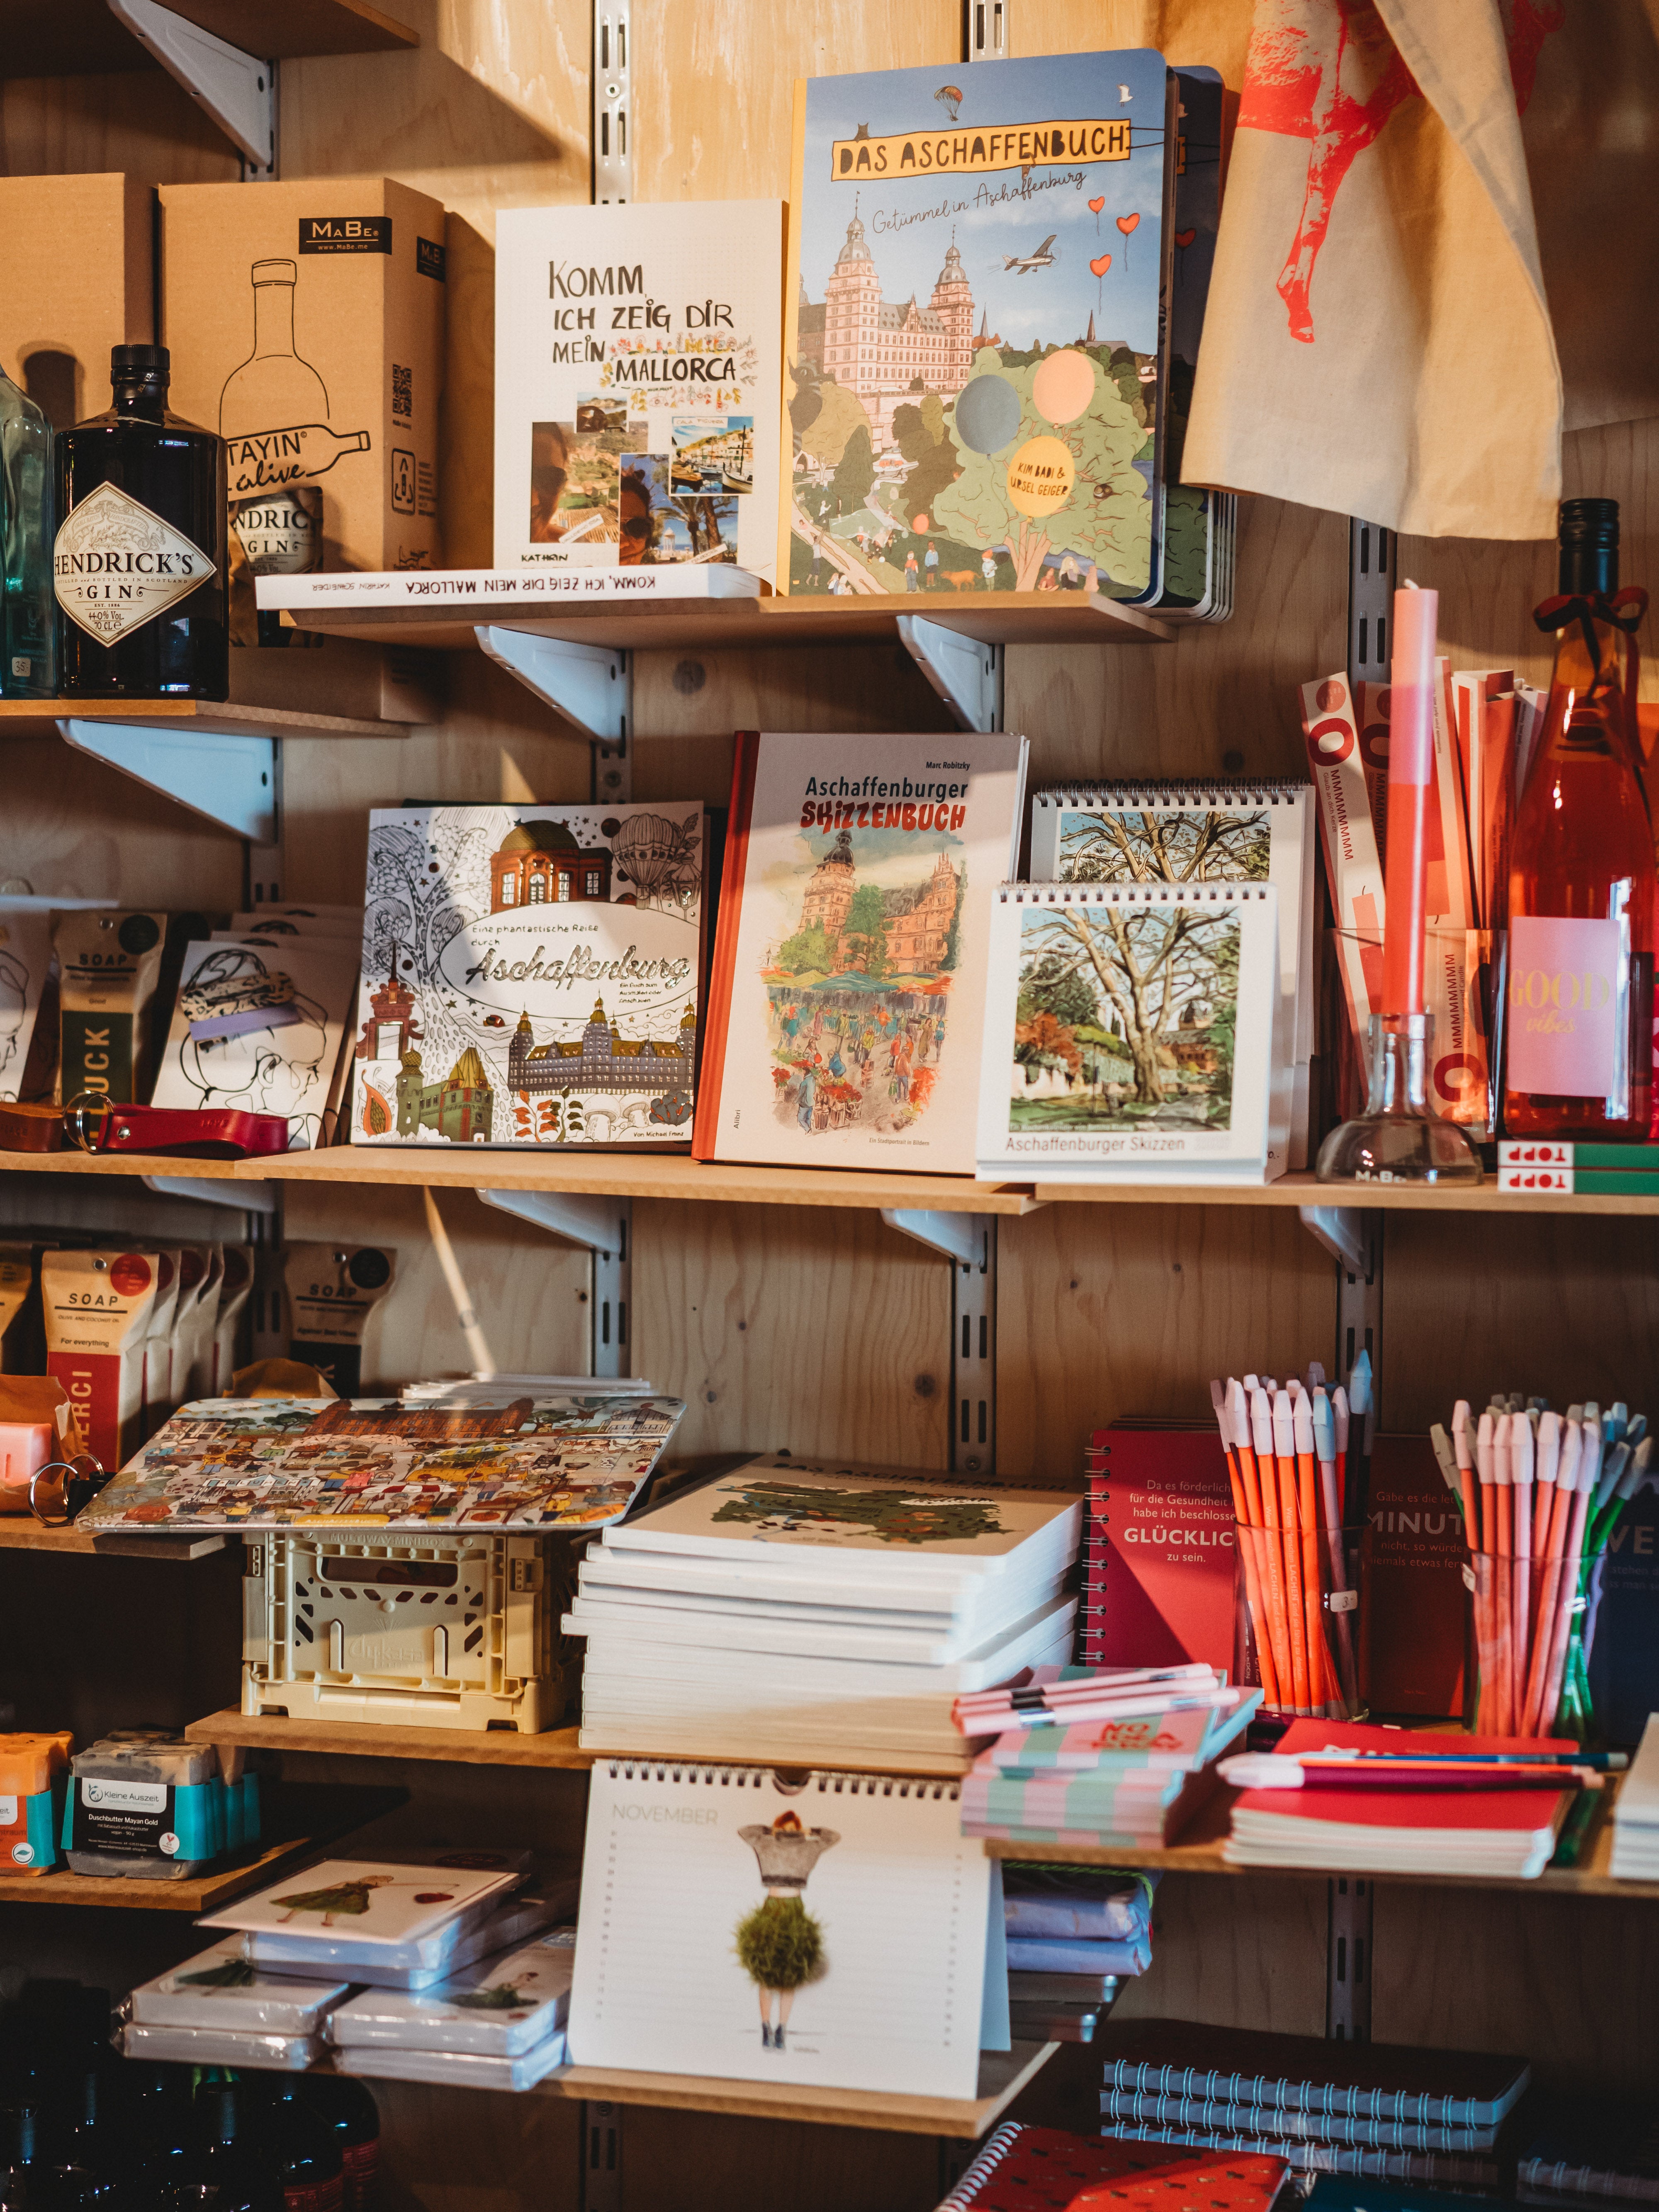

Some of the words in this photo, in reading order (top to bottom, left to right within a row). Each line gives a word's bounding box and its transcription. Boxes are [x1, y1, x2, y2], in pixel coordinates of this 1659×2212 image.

[841, 145, 888, 174] DAS
[901, 125, 1124, 169] ASCHAFFENBUCH
[873, 201, 951, 234] Getümmel
[953, 197, 969, 213] in
[973, 170, 1087, 209] Aschaffenburg
[554, 307, 595, 331] ICH
[612, 299, 671, 333] ZEIG
[686, 299, 734, 329] DIR
[553, 335, 605, 363] MEIN
[616, 357, 736, 382] MALLORCA
[236, 460, 305, 491] alive
[1018, 462, 1033, 476] KIM
[1035, 465, 1055, 478] BADI
[1057, 467, 1065, 479] &
[1011, 476, 1034, 494] URSEL
[1038, 484, 1068, 496] GEIGER
[109, 514, 146, 529] HANDCRAFTED
[248, 540, 288, 552] GIN
[55, 553, 193, 575] HENDRICK'S
[406, 581, 476, 594] MALLORCA
[484, 580, 516, 591] MEIN
[523, 579, 545, 590] DIR
[550, 577, 579, 590] ZEIG
[586, 579, 604, 590] ICH
[87, 585, 132, 599] GIN
[94, 621, 102, 630] 70
[943, 762, 970, 771] Robitzky
[805, 776, 968, 803] Aschaffenburger
[1330, 815, 1338, 832] Kerze
[496, 924, 569, 934] phantastische
[80, 954, 127, 966] SOAP
[465, 945, 690, 990] Aschaffenburg
[1510, 969, 1610, 1010] GOOD
[1527, 1010, 1576, 1033] vibes
[1006, 1137, 1125, 1154] Aschaffenburger
[1130, 1137, 1185, 1151] Skizzen
[1508, 1147, 1566, 1161] TOPP
[1508, 1174, 1566, 1188] TOPP
[310, 1284, 357, 1298] SOAP
[68, 1293, 118, 1306] SOAP
[74, 1339, 109, 1348] everything
[1147, 1480, 1161, 1490] Da
[1180, 1481, 1230, 1492] förderlich
[1130, 1493, 1144, 1503] für
[1148, 1494, 1163, 1504] die
[1167, 1494, 1227, 1506] Gesundheit
[1408, 1494, 1418, 1502] es
[1422, 1493, 1437, 1503] die
[1133, 1507, 1158, 1518] habe
[1162, 1509, 1176, 1518] ich
[1180, 1510, 1236, 1521] beschlosse
[1124, 1525, 1233, 1546] GLÜCKLIC
[1381, 1541, 1410, 1551] nicht,
[1429, 1543, 1463, 1553] würde
[1182, 1553, 1206, 1562] sein.
[1410, 1559, 1440, 1568] etwas
[1269, 1562, 1279, 1599] LACHEN
[1289, 1564, 1298, 1601] LACHEN
[105, 1791, 127, 1799] Kleine
[129, 1793, 159, 1802] Auszeit
[89, 1814, 123, 1822] Duschbutter
[613, 1804, 718, 1825] NOVEMBER
